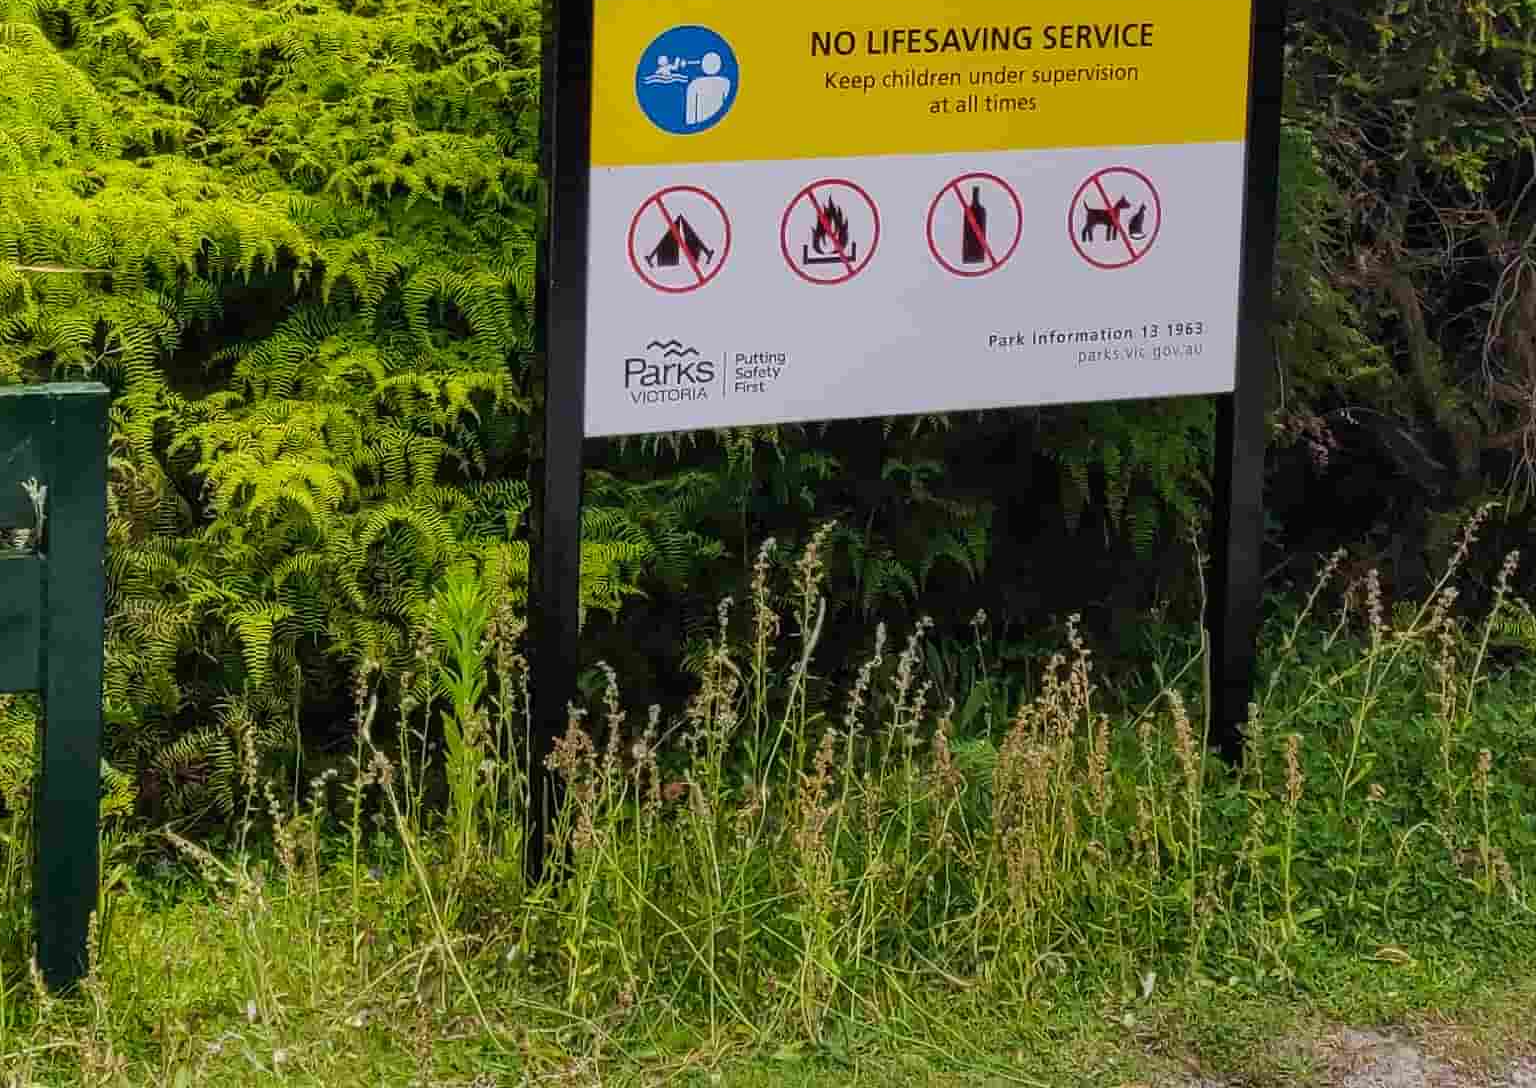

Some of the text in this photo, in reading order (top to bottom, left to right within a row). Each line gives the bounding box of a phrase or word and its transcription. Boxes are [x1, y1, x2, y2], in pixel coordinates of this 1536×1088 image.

[811, 23, 1153, 57] NO LIFESAVING SERVICE
[825, 62, 1138, 93] Keep children under supervision
[929, 93, 1036, 115] at all times
[988, 322, 1203, 348] Park Information 13 1963
[735, 353, 786, 365] Putting
[1078, 344, 1203, 365] parks.vicgov.au
[625, 358, 714, 388] Parks
[631, 387, 707, 404] VICTORIA
